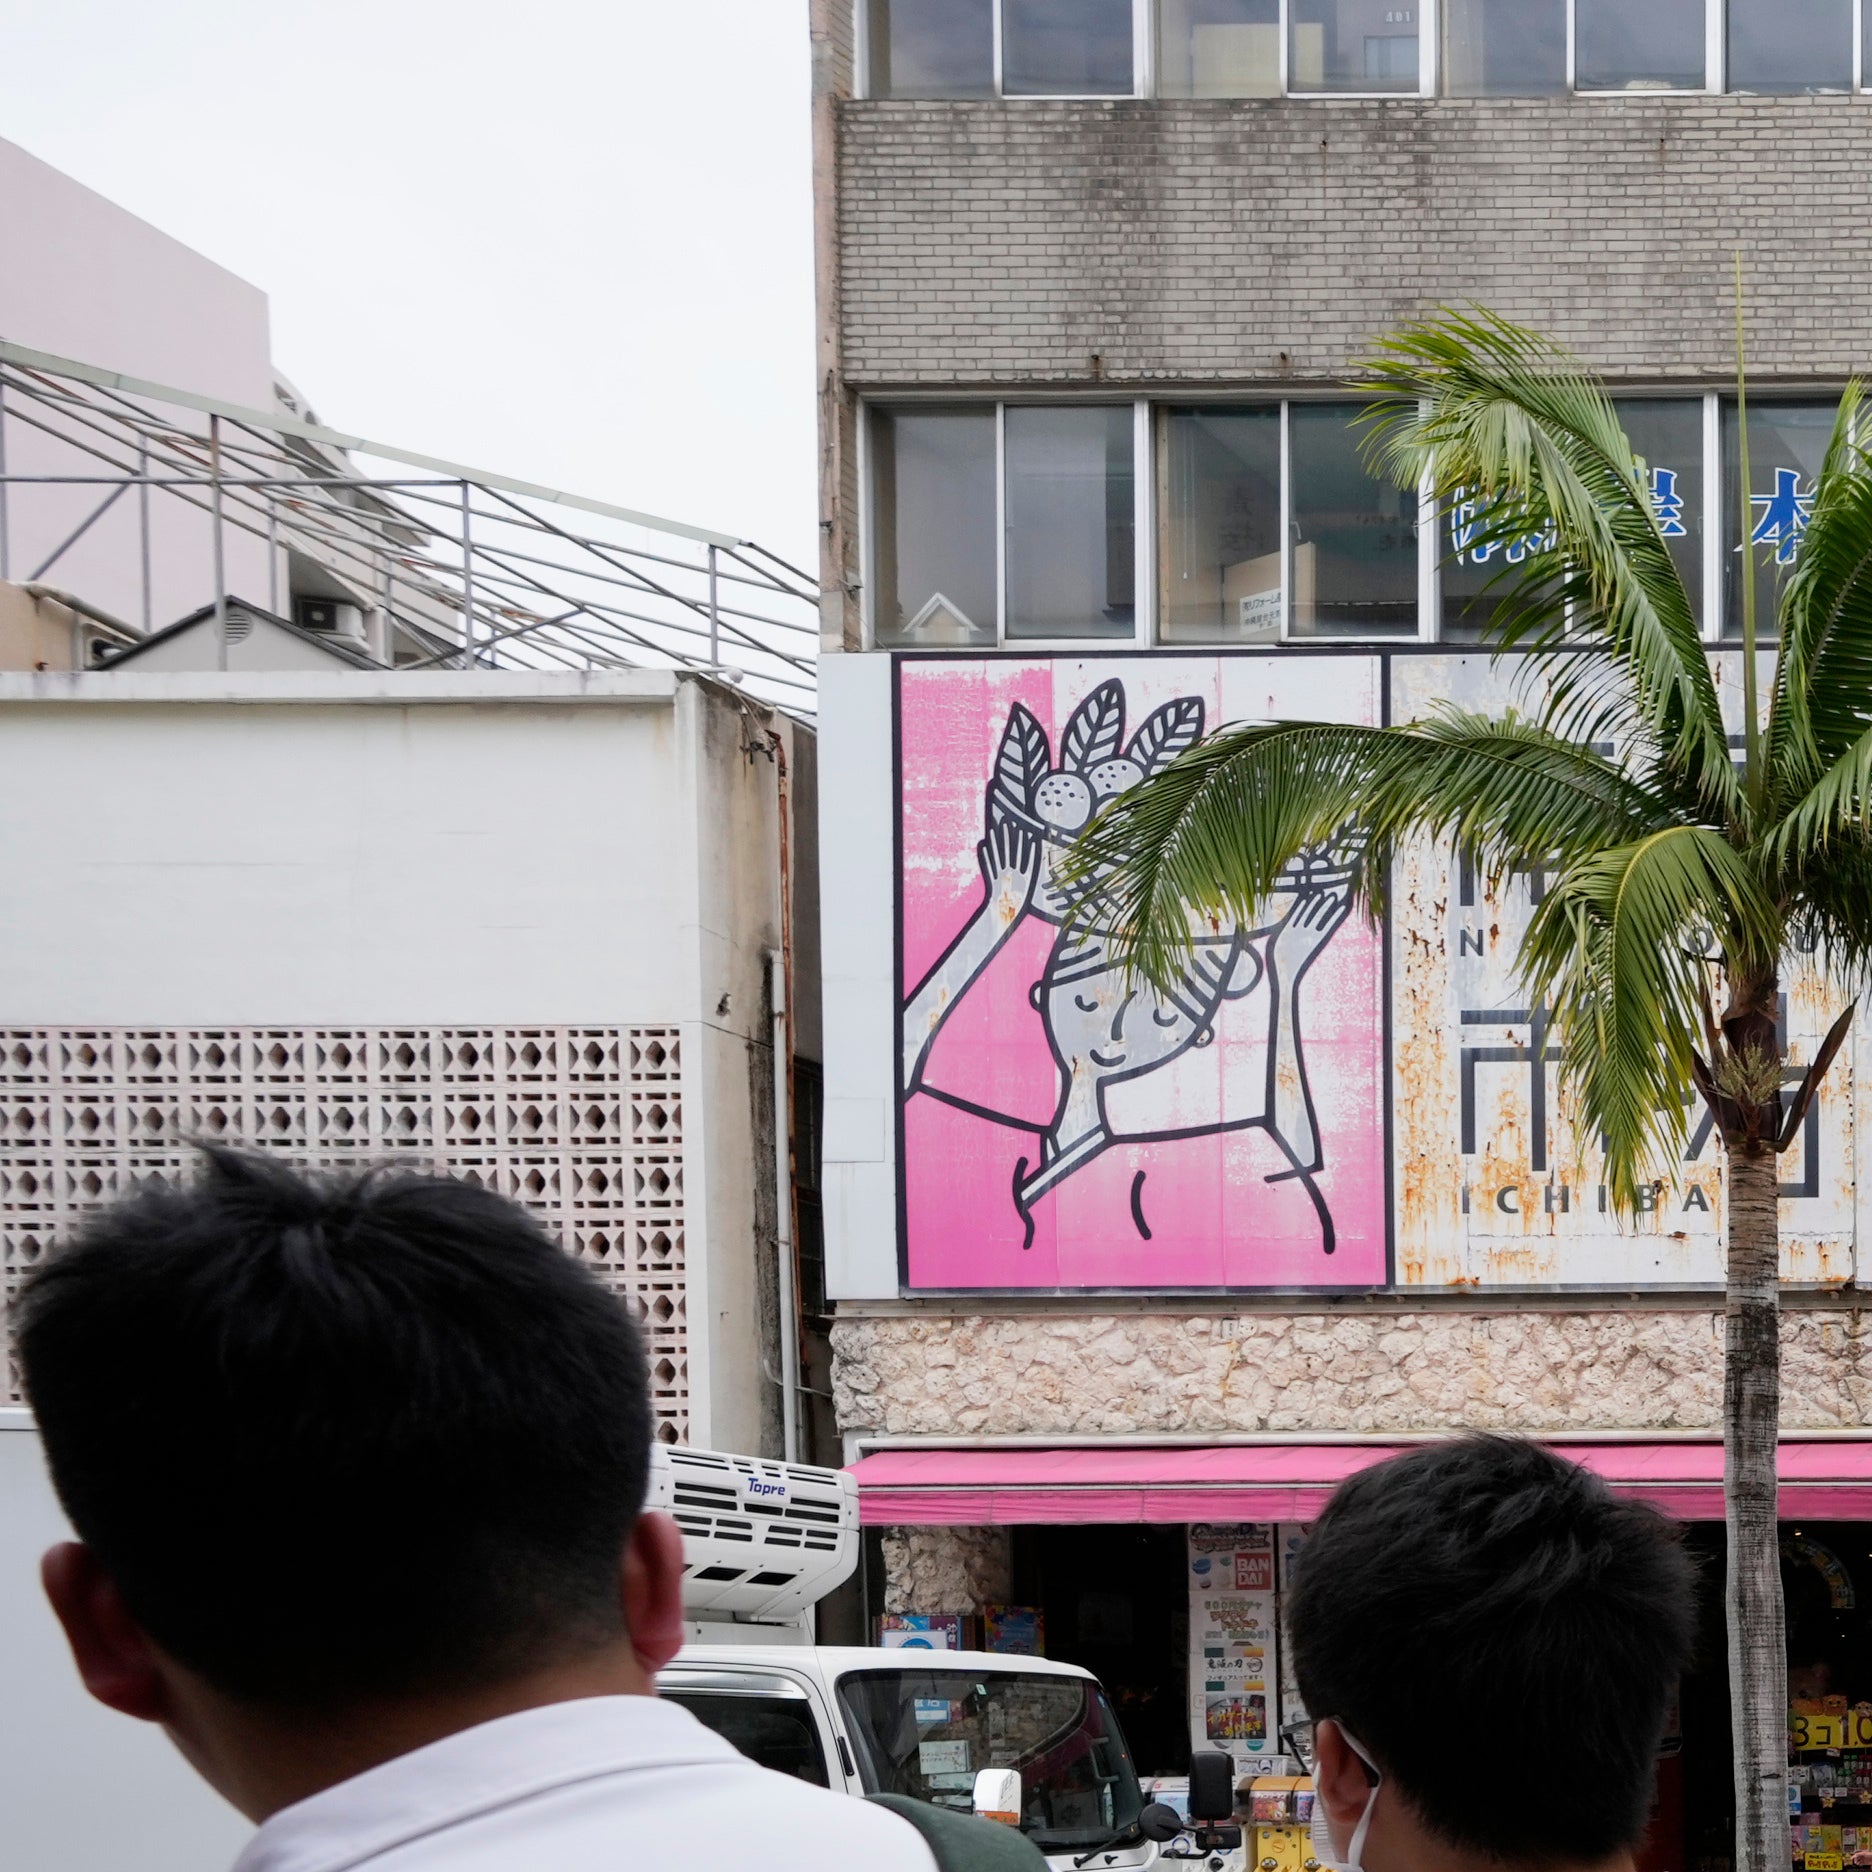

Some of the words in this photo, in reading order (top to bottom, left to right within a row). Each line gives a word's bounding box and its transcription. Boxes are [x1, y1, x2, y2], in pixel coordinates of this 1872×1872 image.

[1461, 1184, 1710, 1214] ICHIBA
[747, 1477, 787, 1497] Topre
[1236, 1557, 1271, 1573] BAN
[1237, 1572, 1265, 1587] DAI
